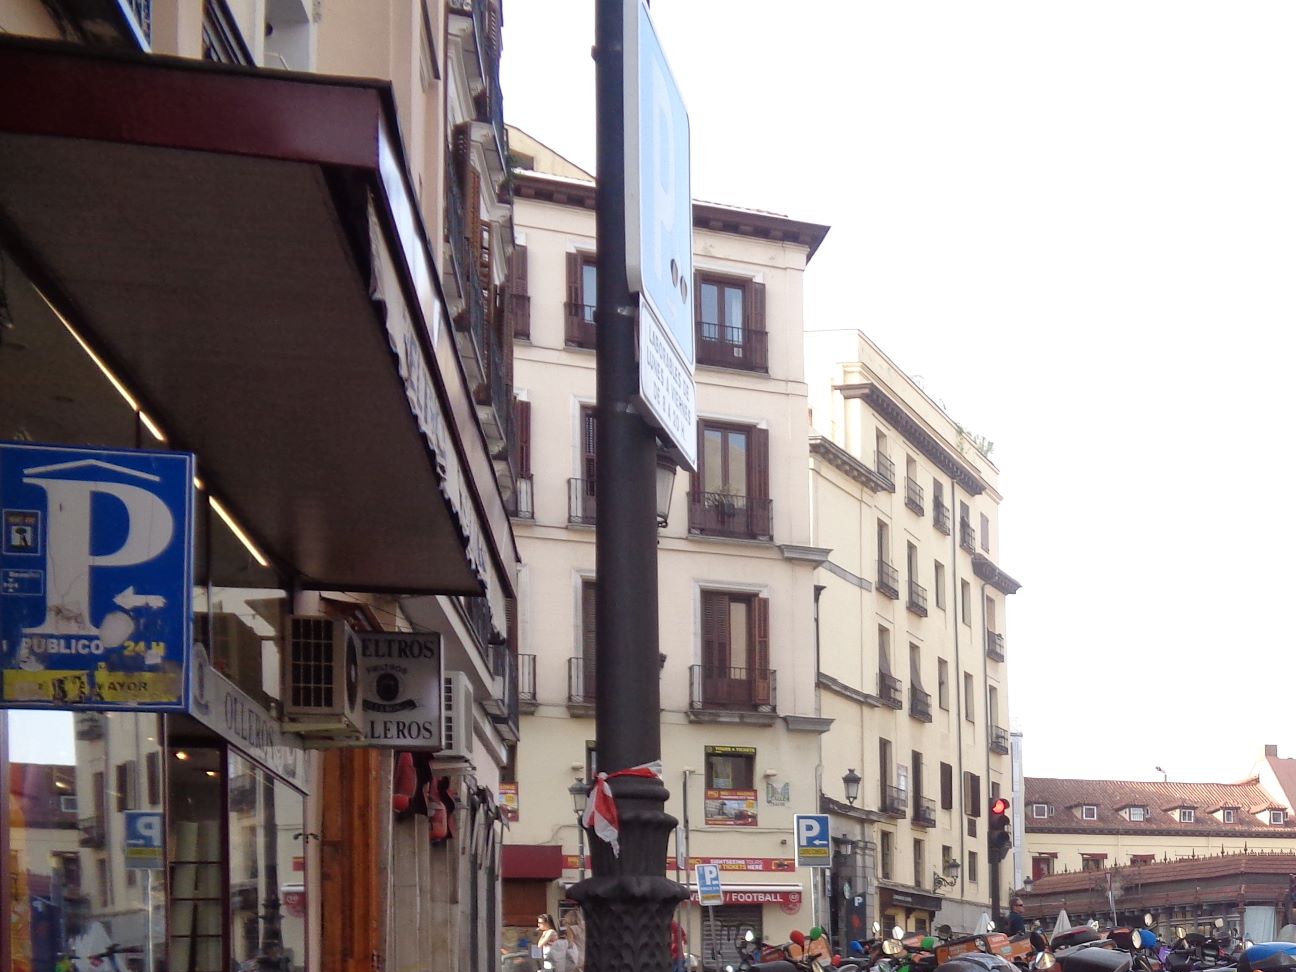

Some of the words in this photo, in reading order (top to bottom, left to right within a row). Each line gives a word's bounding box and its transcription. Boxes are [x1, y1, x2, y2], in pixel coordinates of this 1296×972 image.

[651, 58, 676, 281] P
[648, 323, 682, 383] LABORABLES
[646, 345, 664, 387] LUNES
[671, 384, 692, 426] VIERNES
[22, 476, 174, 636] P
[123, 640, 146, 656] 24
[100, 680, 148, 692] AYOR
[364, 719, 433, 740] LEROS
[799, 818, 820, 846] P
[703, 865, 718, 885] P
[732, 893, 784, 902] FOOTBALL
[854, 896, 863, 907] P
